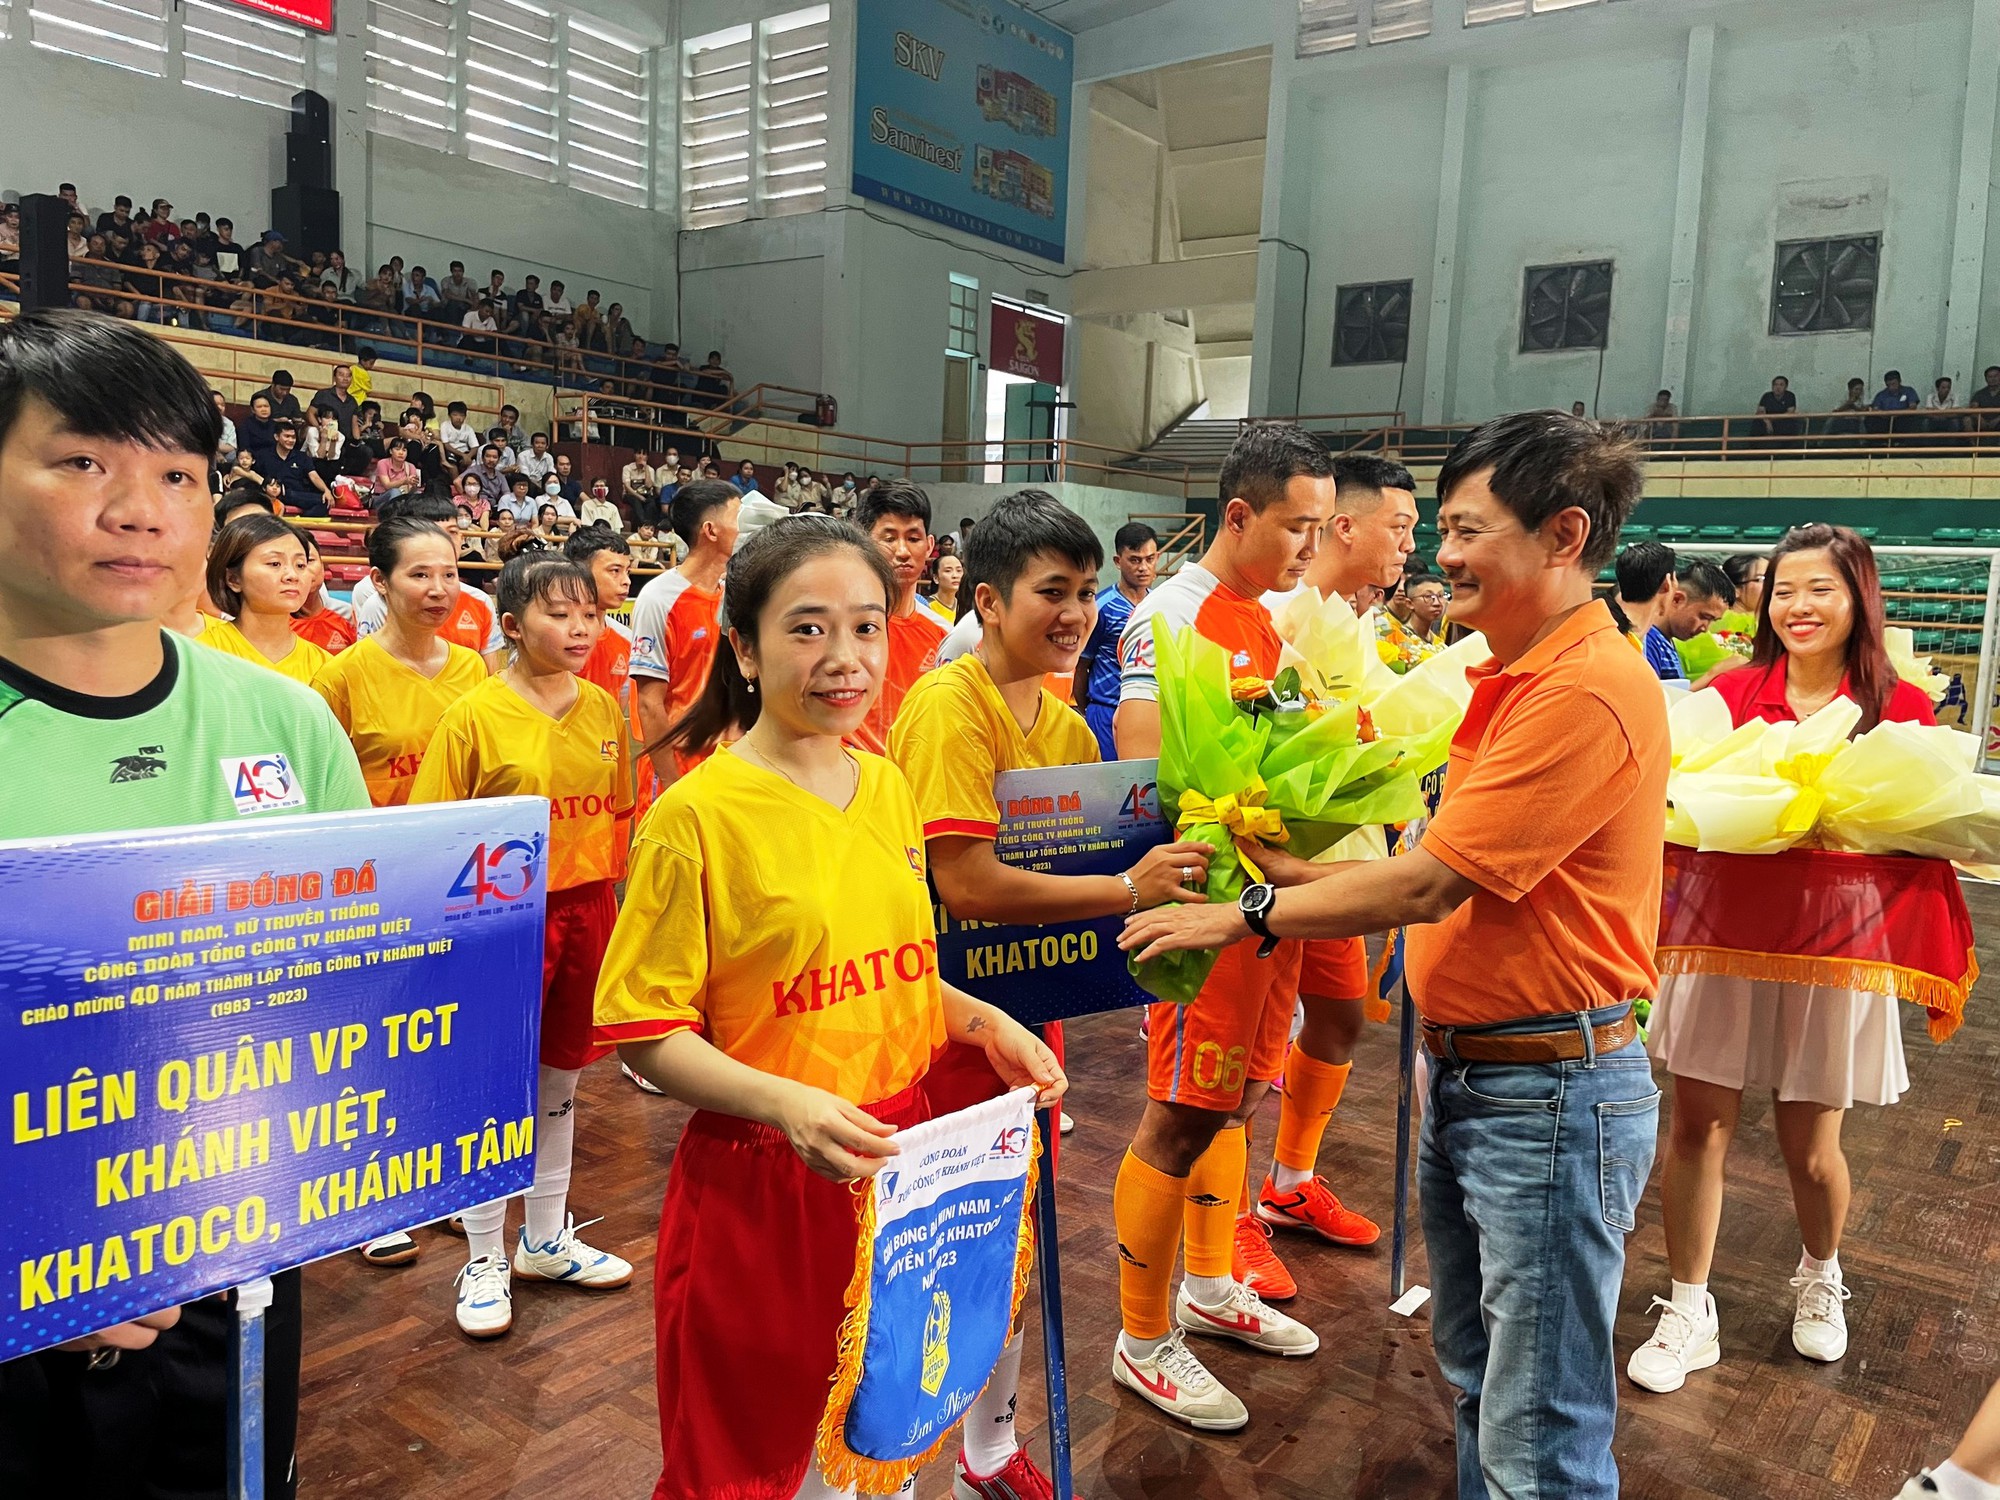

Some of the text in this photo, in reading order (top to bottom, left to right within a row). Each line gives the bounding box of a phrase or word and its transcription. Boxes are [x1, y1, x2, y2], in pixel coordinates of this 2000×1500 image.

[895, 31, 946, 82] SKV
[870, 105, 963, 174] Sanvinest
[1009, 359, 1040, 377] SAIGON
[550, 794, 617, 821] ATOC
[1008, 795, 1054, 818] BÓNG
[1057, 790, 1081, 812] ĐÁ
[134, 859, 376, 923] GIẢI BÓNG ĐÁ
[84, 918, 412, 983] CÔNG ĐOÀN TỔNG CÔNG TY KHÁNH VIỆT
[128, 931, 174, 952] MINI
[235, 917, 259, 936] NỮ
[264, 907, 324, 932] TRUYỀN
[331, 901, 380, 922] THỐNG
[773, 939, 937, 1018] KHATOC
[966, 930, 1098, 979] KHATOCO
[21, 938, 453, 1025] CHÀO MỪNG 40 NĂM THÀNH LẬP TỔNG CÔNG TY KHÁNH VIỆT
[211, 997, 251, 1018] (1983
[268, 987, 308, 1007] 2023)
[13, 1003, 460, 1144] LIÊN QUÂN VP TCT
[1192, 1041, 1246, 1093] 06
[95, 1087, 398, 1208] KHÁNH VIỆT,
[19, 1115, 535, 1311] KHATOCO, KHÁNH TÂM
[894, 1227, 927, 1252] BÓNG
[959, 1199, 990, 1216] NAM
[936, 1250, 957, 1271] 023
